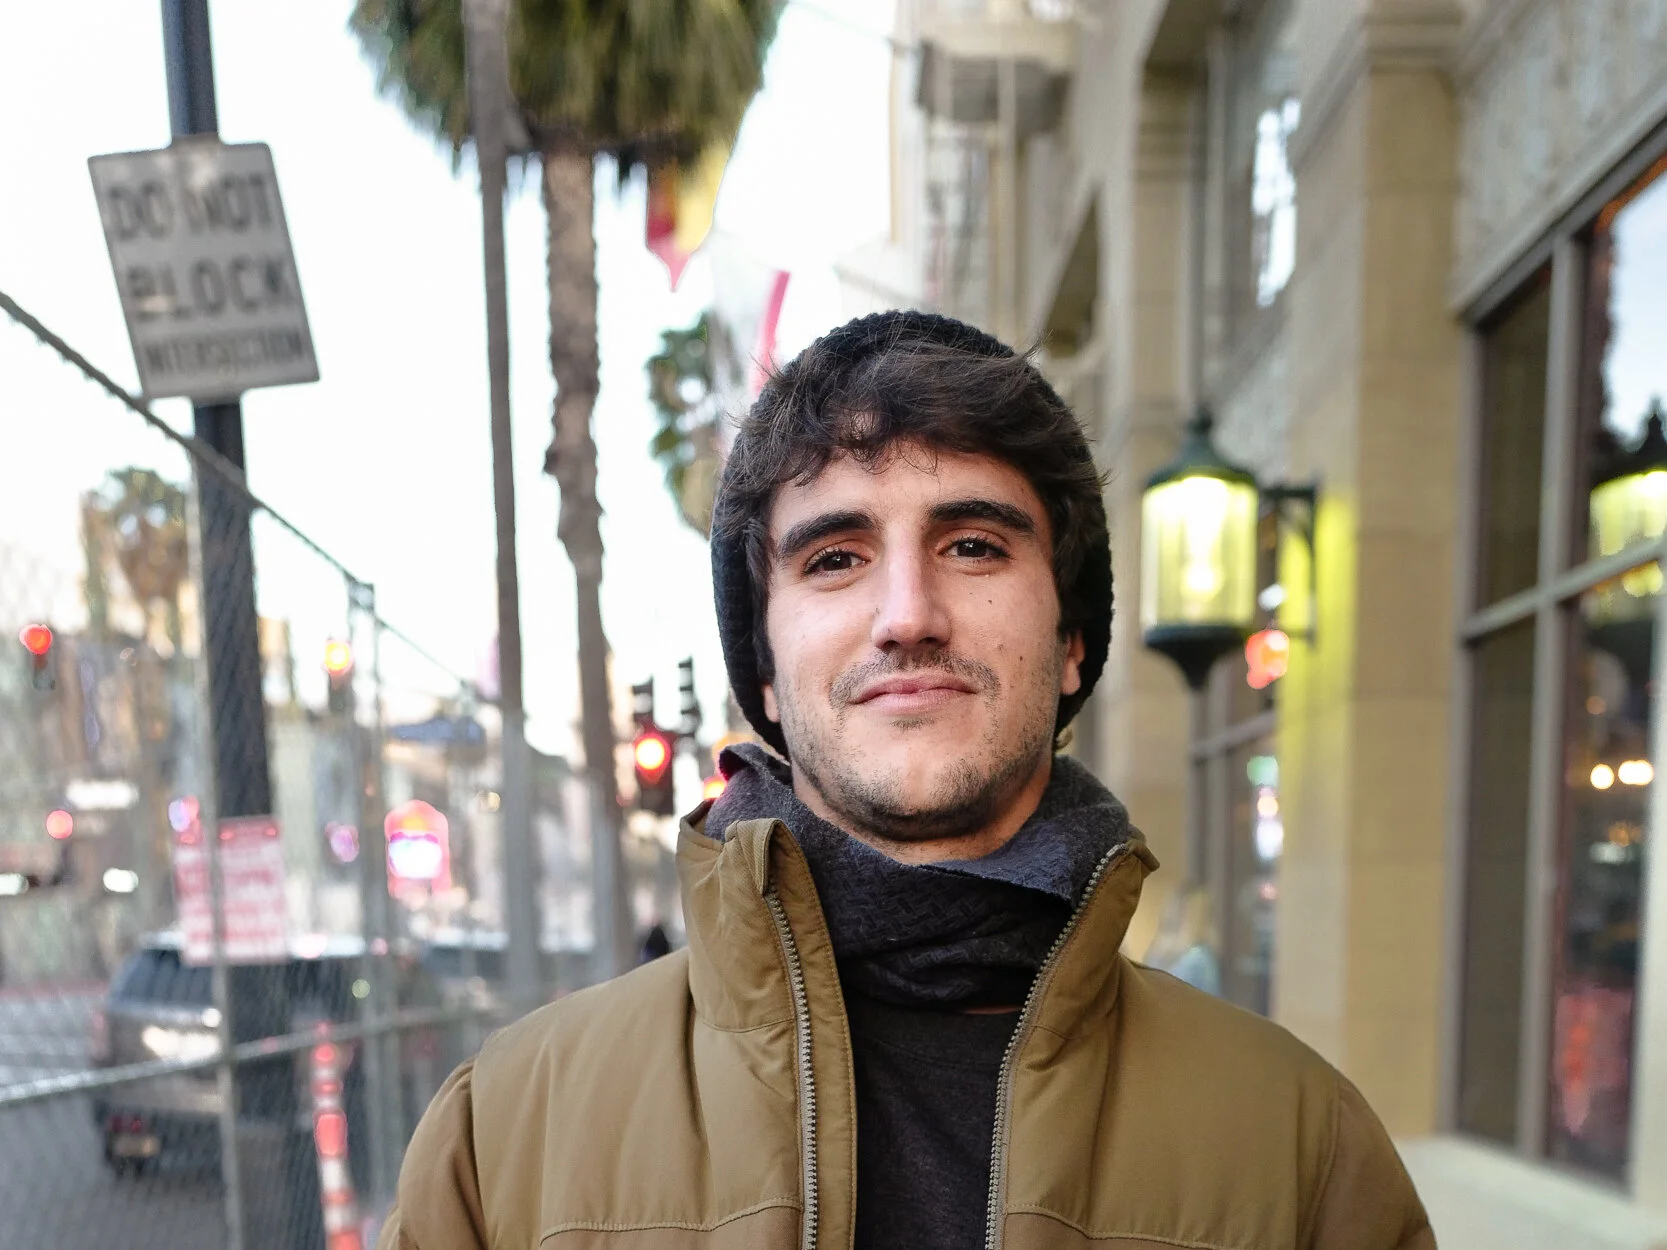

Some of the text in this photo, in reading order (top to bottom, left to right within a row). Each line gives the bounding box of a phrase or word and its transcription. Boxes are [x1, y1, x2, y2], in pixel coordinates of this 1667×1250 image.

[107, 172, 275, 240] DO NOT
[126, 255, 296, 322] BLOCK
